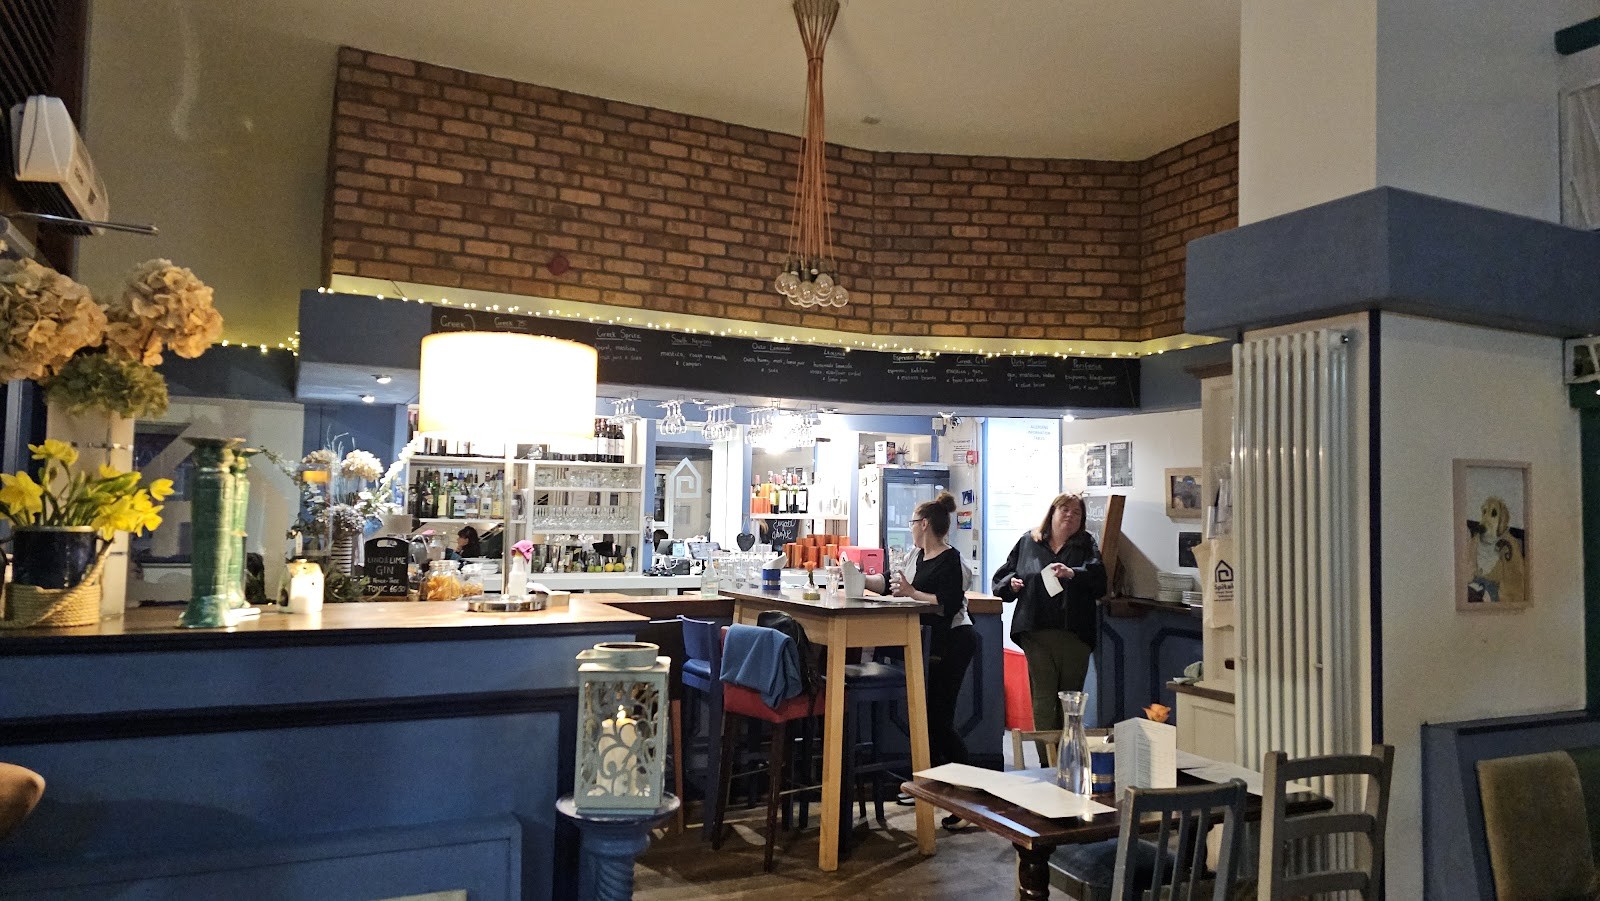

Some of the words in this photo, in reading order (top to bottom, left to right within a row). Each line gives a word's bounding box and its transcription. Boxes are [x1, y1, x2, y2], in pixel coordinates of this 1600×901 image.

[389, 556, 406, 565] LIME
[375, 565, 394, 576] GIN
[367, 585, 388, 593] TONIC
